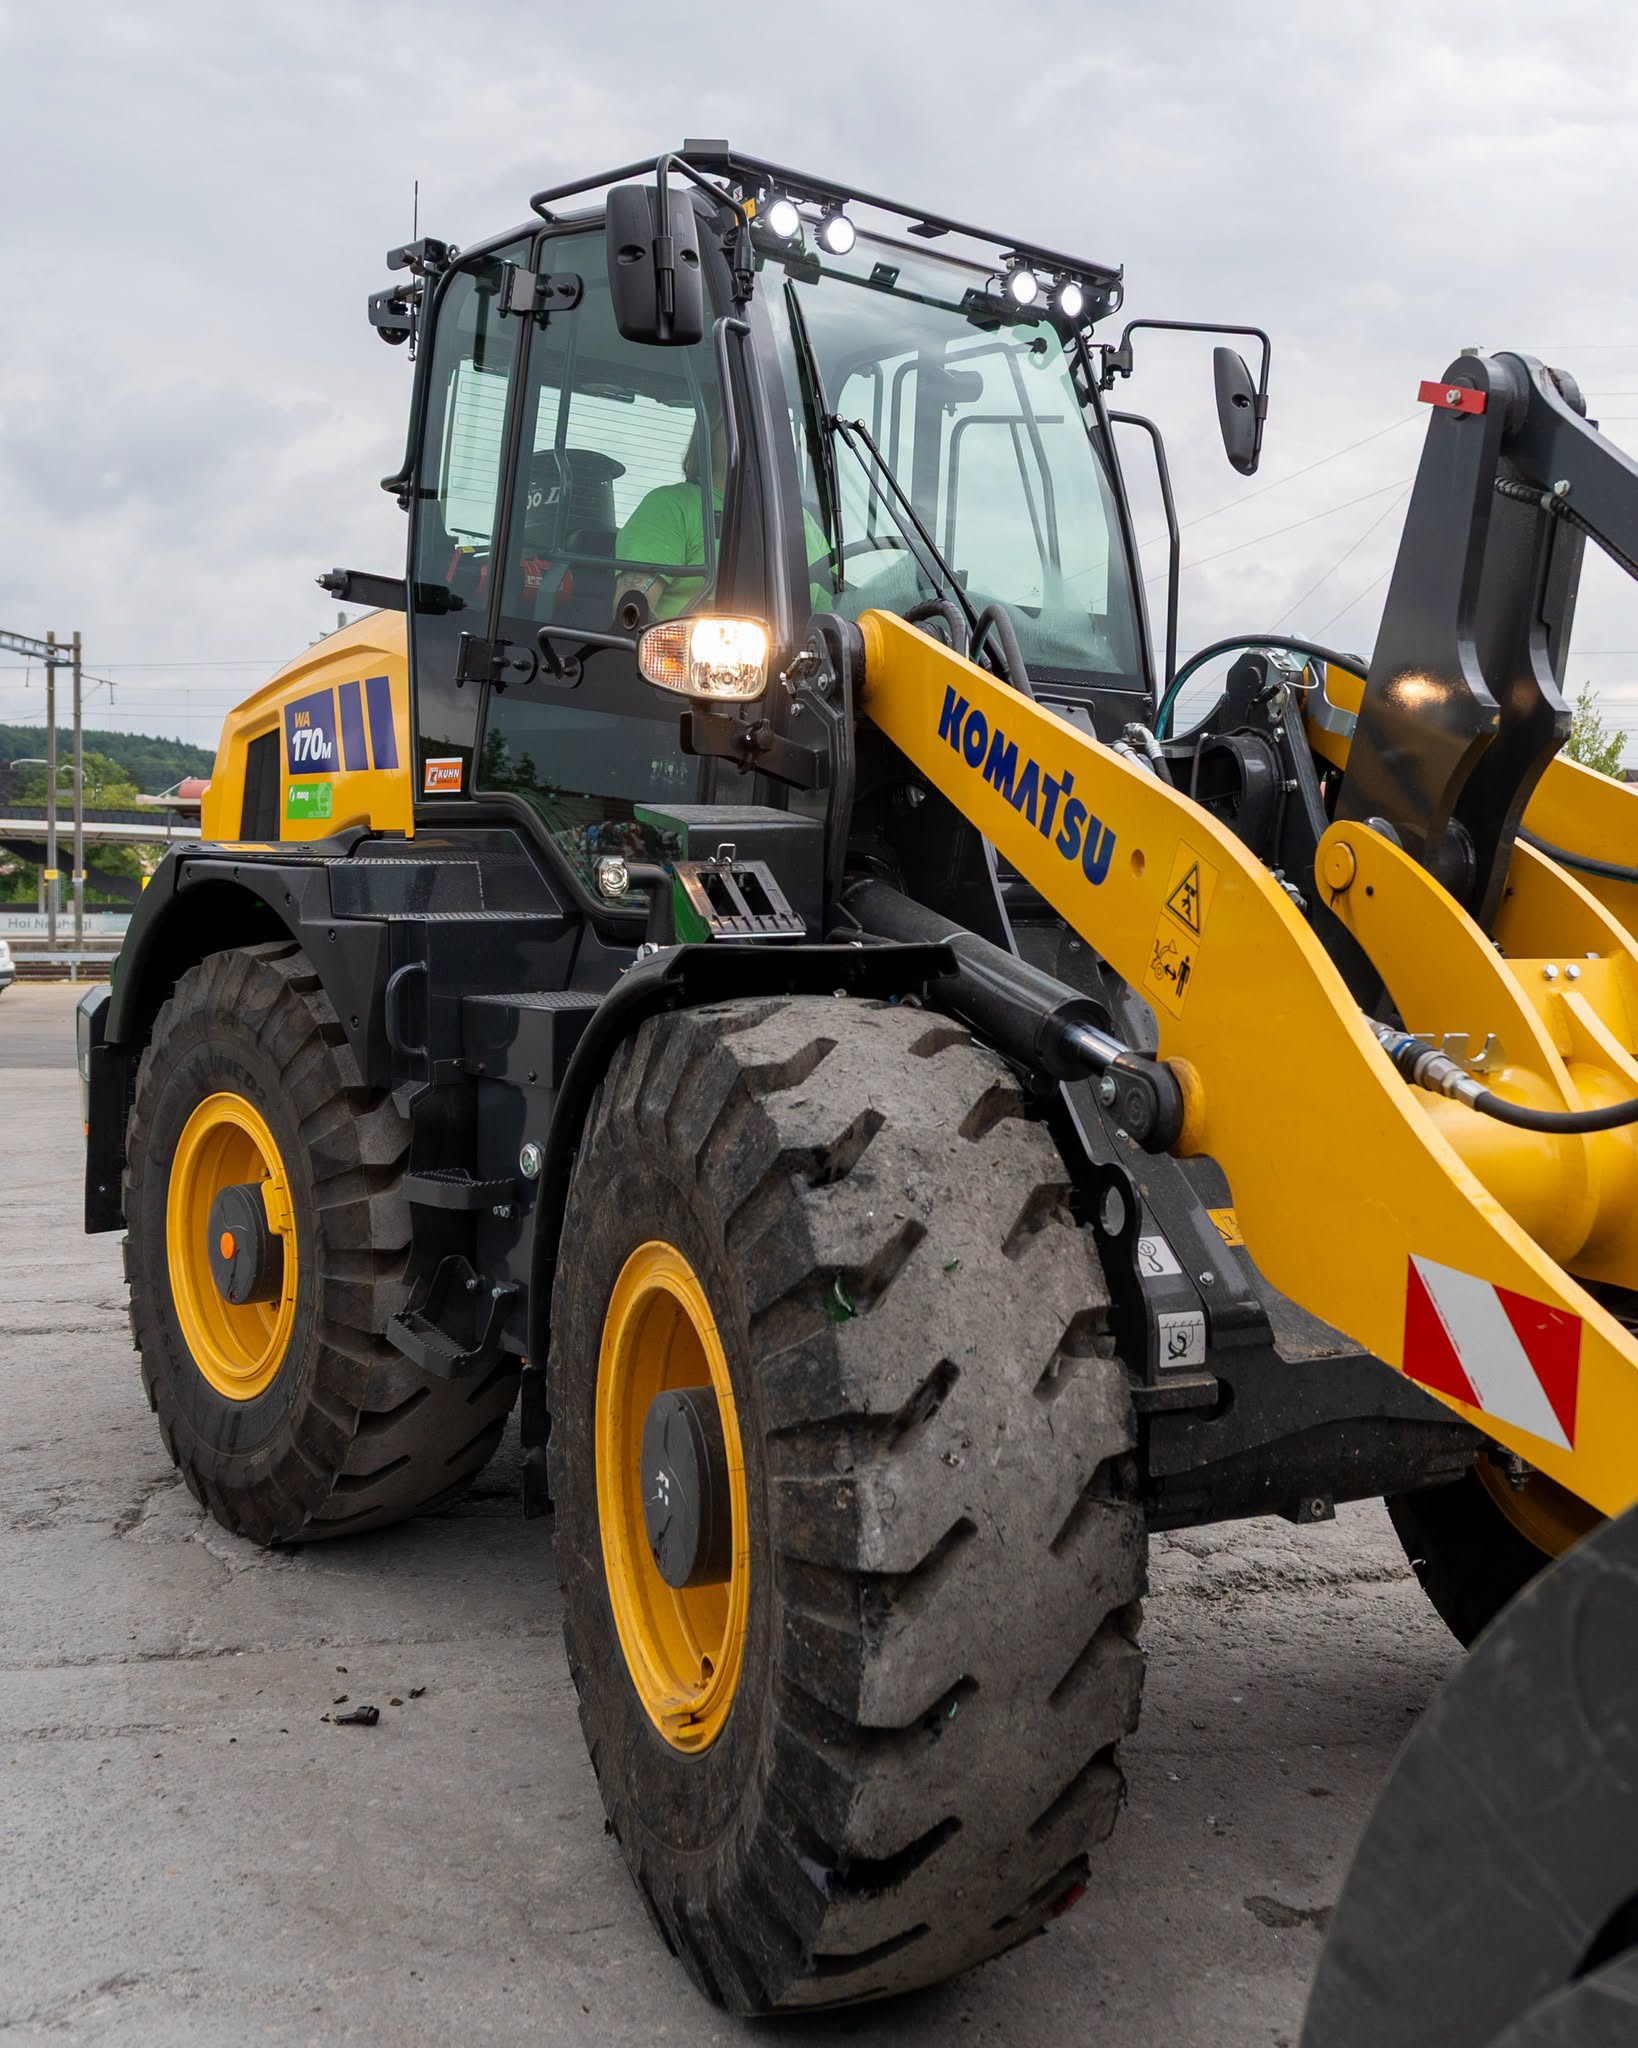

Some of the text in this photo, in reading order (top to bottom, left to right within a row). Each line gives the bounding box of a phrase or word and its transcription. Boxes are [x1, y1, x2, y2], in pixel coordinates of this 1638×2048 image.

[294, 711, 310, 728] WA
[437, 768, 460, 779] KUHN
[938, 684, 1117, 886] KOMATSU
[8, 918, 31, 929] Hoi
